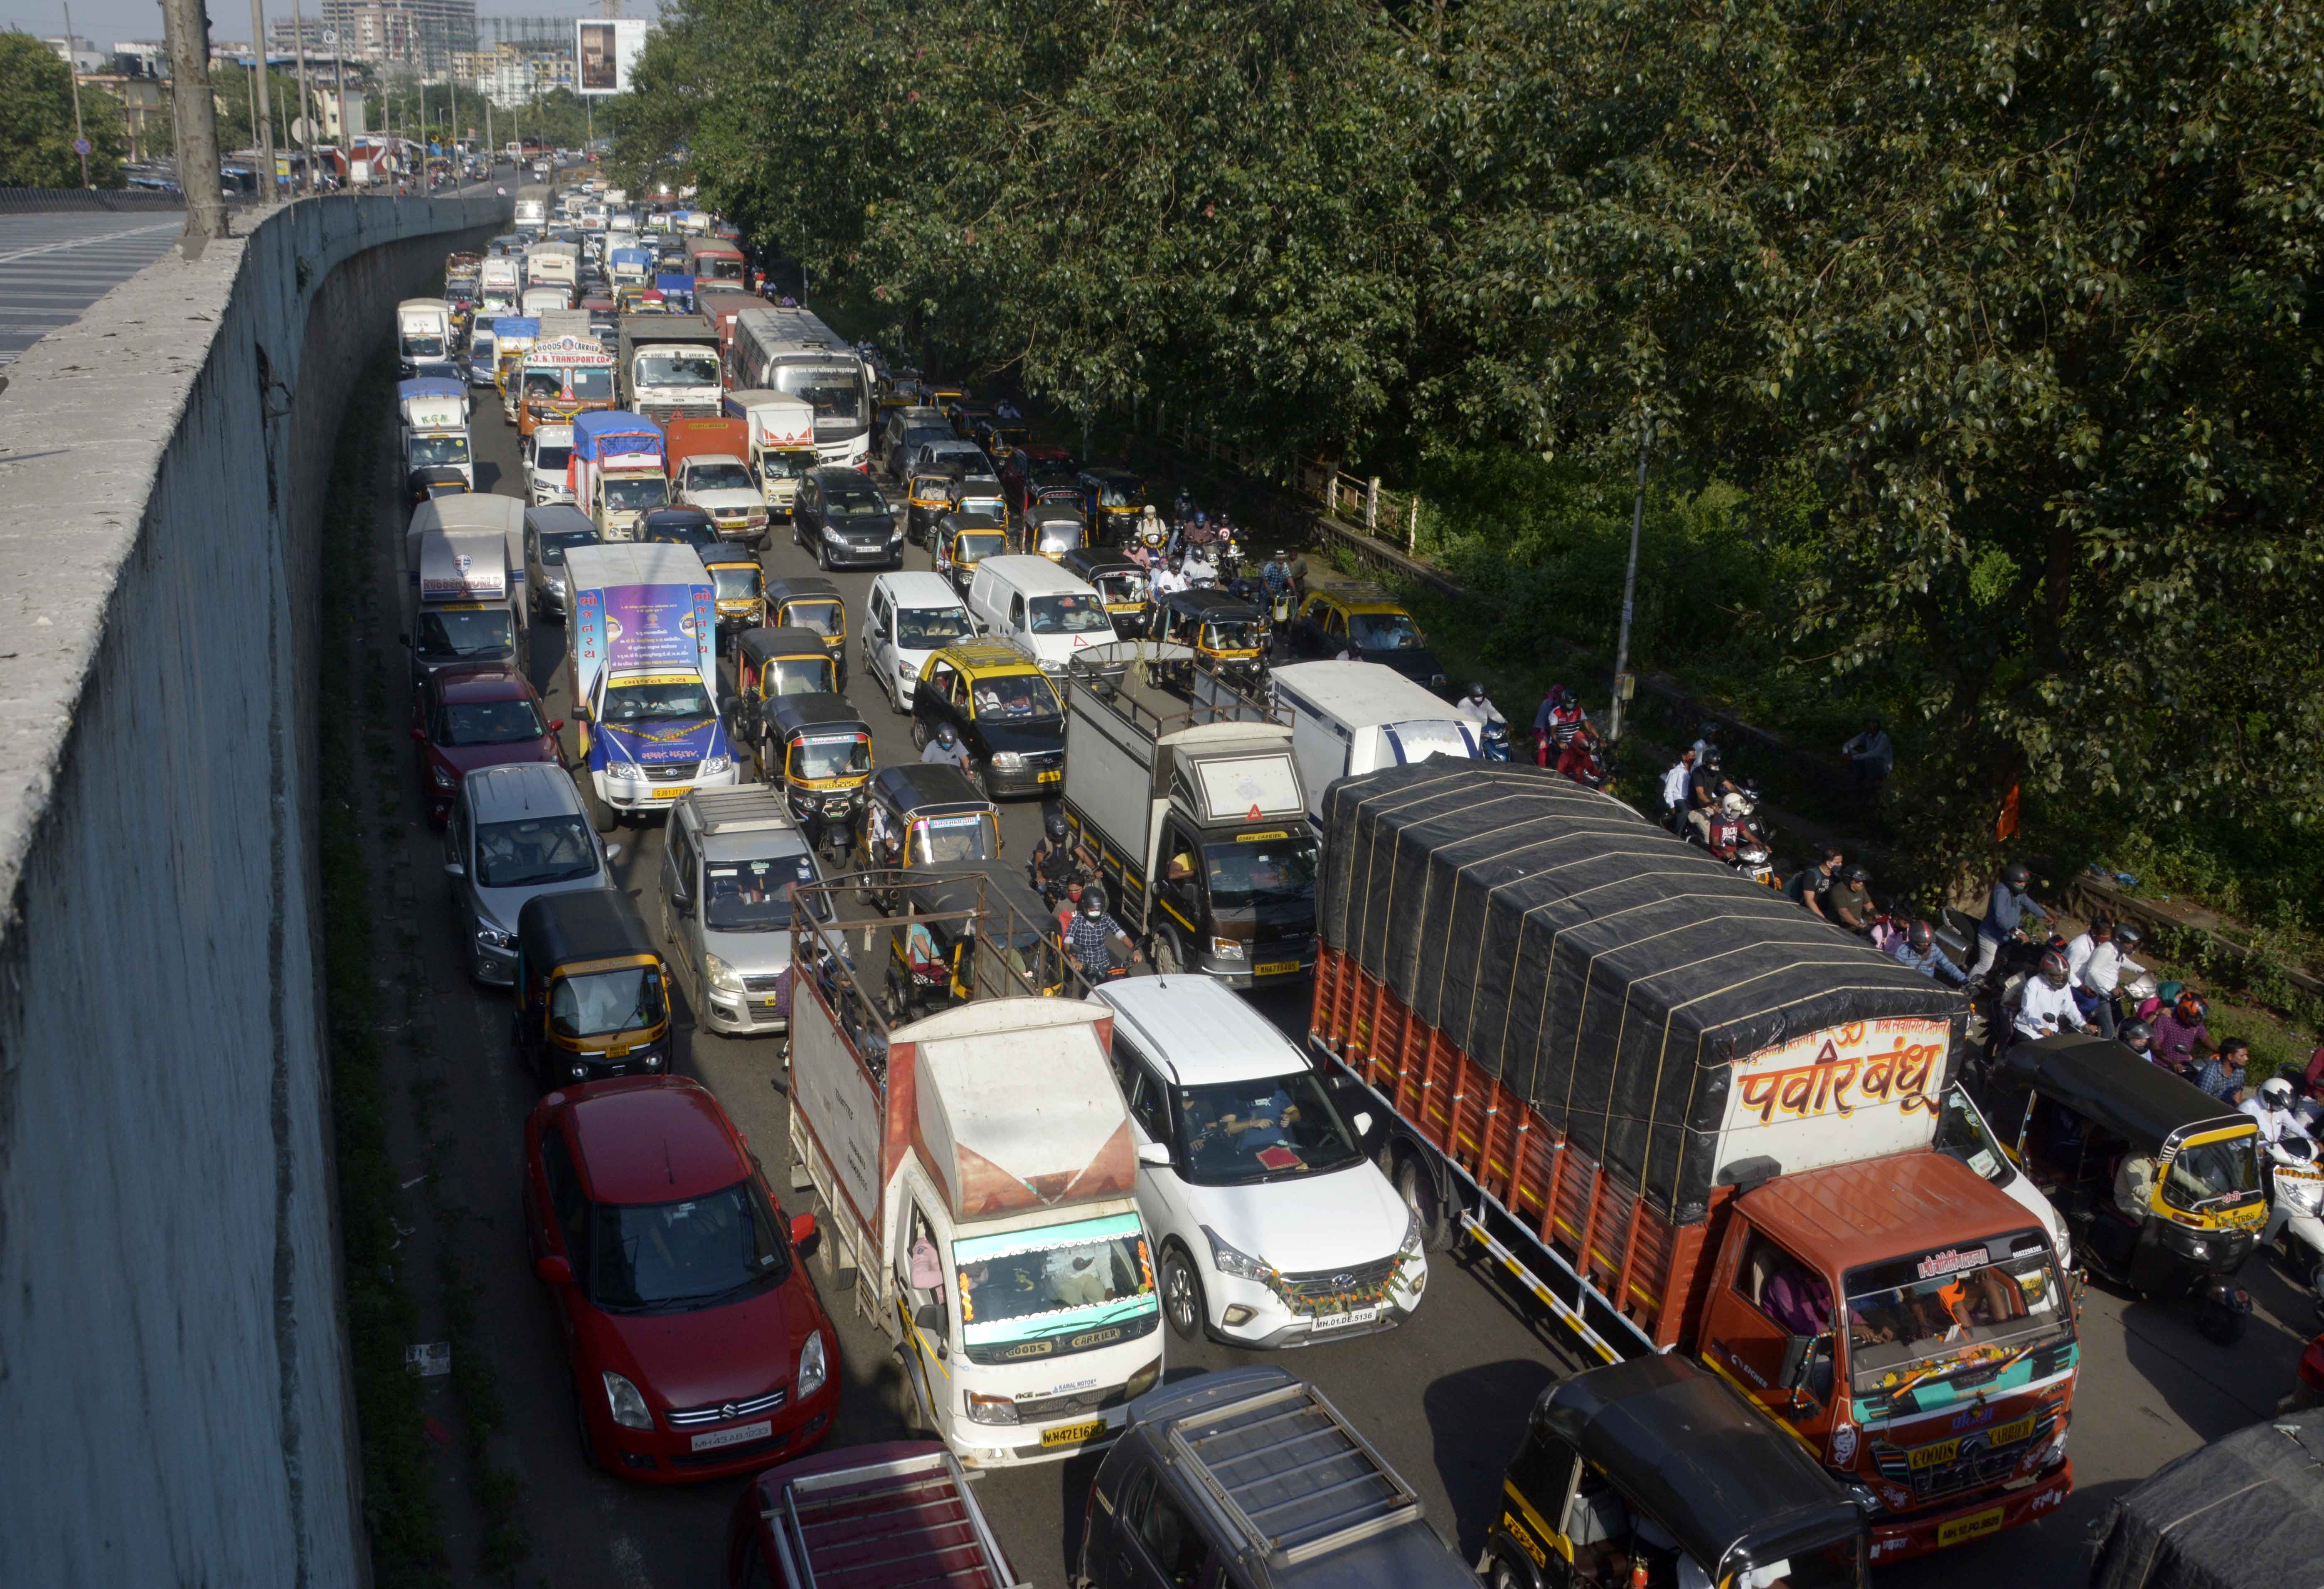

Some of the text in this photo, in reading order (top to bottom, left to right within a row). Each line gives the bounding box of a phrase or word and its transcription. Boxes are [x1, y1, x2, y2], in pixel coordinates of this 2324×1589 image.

[537, 342, 599, 352] GOODS CARRIER
[423, 576, 502, 589] RUBBER WORLD
[1737, 1057, 1864, 1127] पवार
[1315, 1312, 1373, 1328] MH.01.DE.5136
[1007, 1329, 1116, 1356] GOODS CARRIER
[1743, 1363, 1768, 1389] EICHER
[1059, 1382, 1076, 1391] KAMAL
[1015, 1391, 1033, 1400] ACE
[1913, 1419, 2031, 1468] GOODS CARRIER
